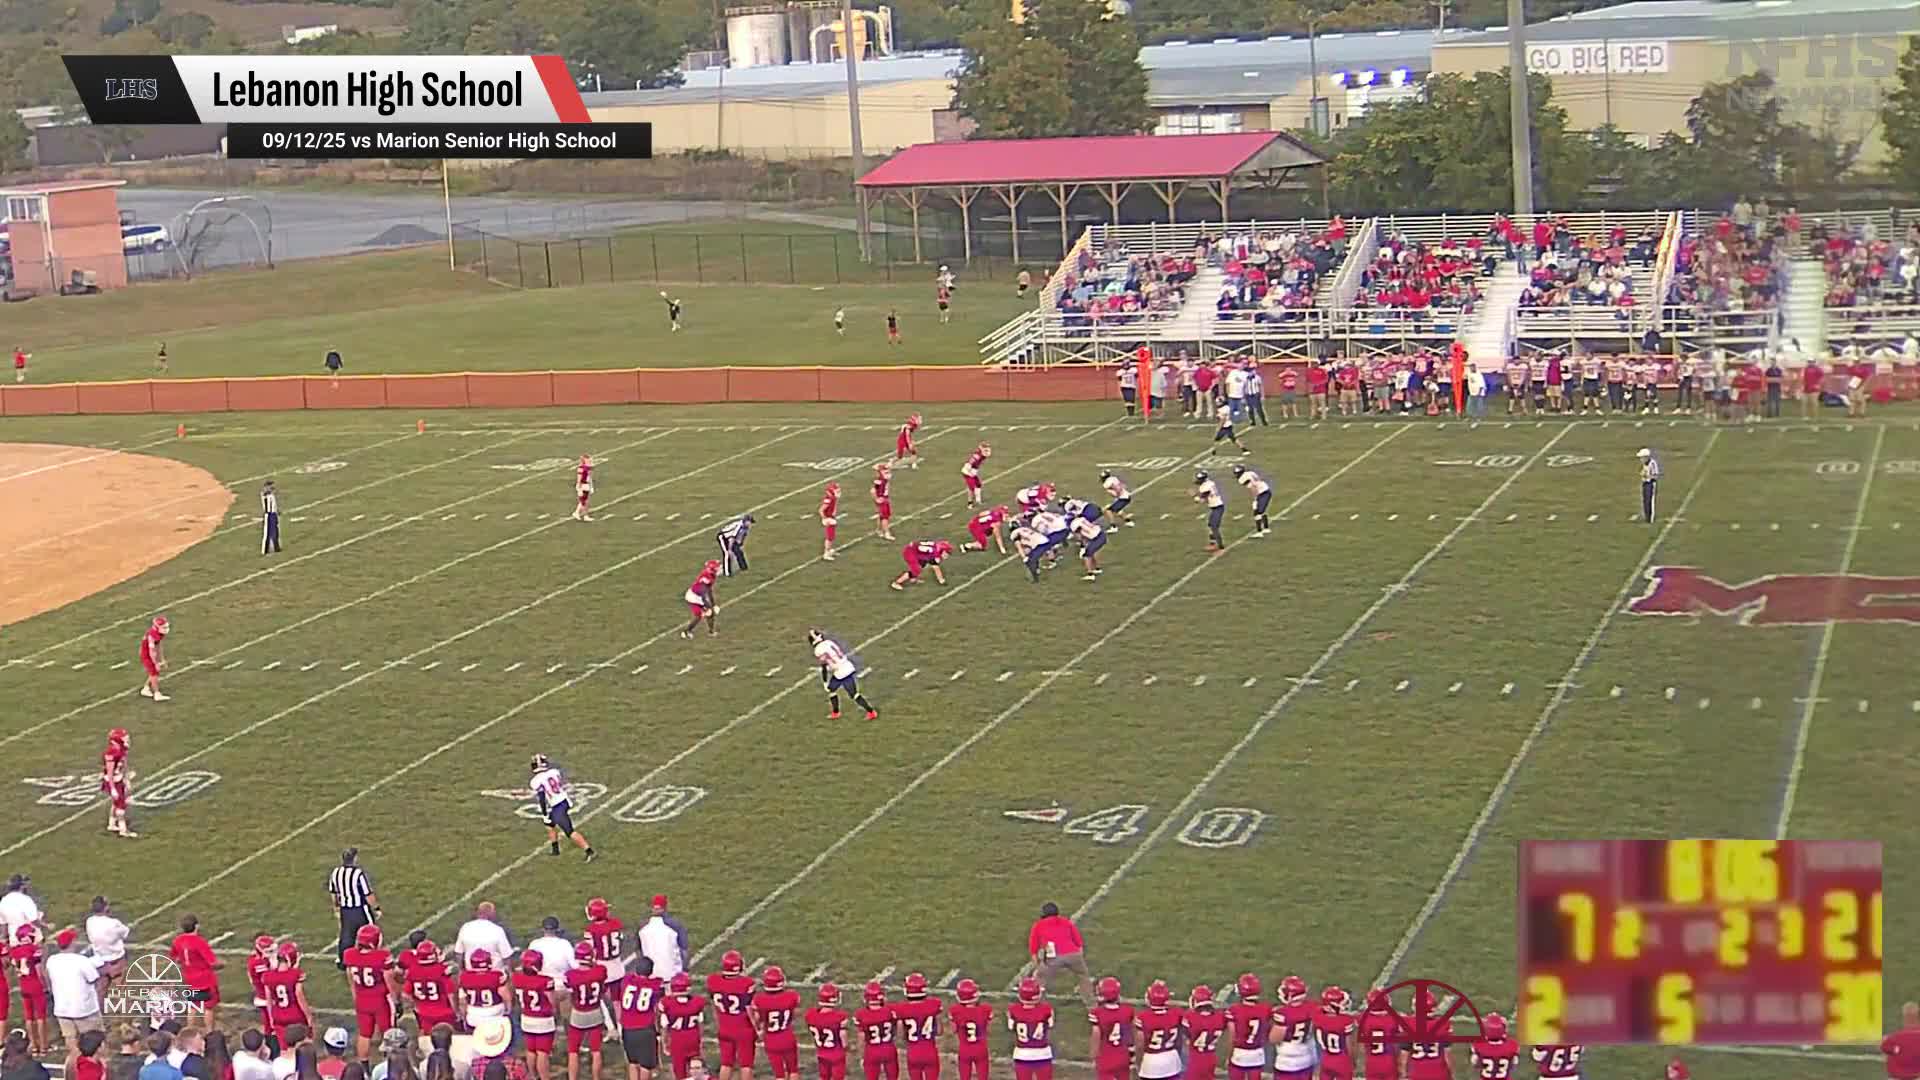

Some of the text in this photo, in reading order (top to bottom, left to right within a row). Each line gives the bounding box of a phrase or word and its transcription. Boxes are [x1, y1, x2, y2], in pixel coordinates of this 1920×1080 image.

[1530, 45, 1664, 69] GO BIG RED
[1558, 893, 1594, 963] 7
[1720, 906, 1749, 967] 2
[275, 984, 290, 1008] 9
[578, 982, 601, 1006] 13
[622, 985, 653, 1012] 68
[767, 1009, 791, 1032] 51
[1526, 974, 1562, 1044] 2
[1657, 973, 1695, 1044] 5
[869, 1022, 892, 1044] 33
[904, 1015, 934, 1042] 24
[966, 1022, 977, 1042] 3
[1108, 1022, 1121, 1046] 4
[1481, 1058, 1510, 1078] 23
